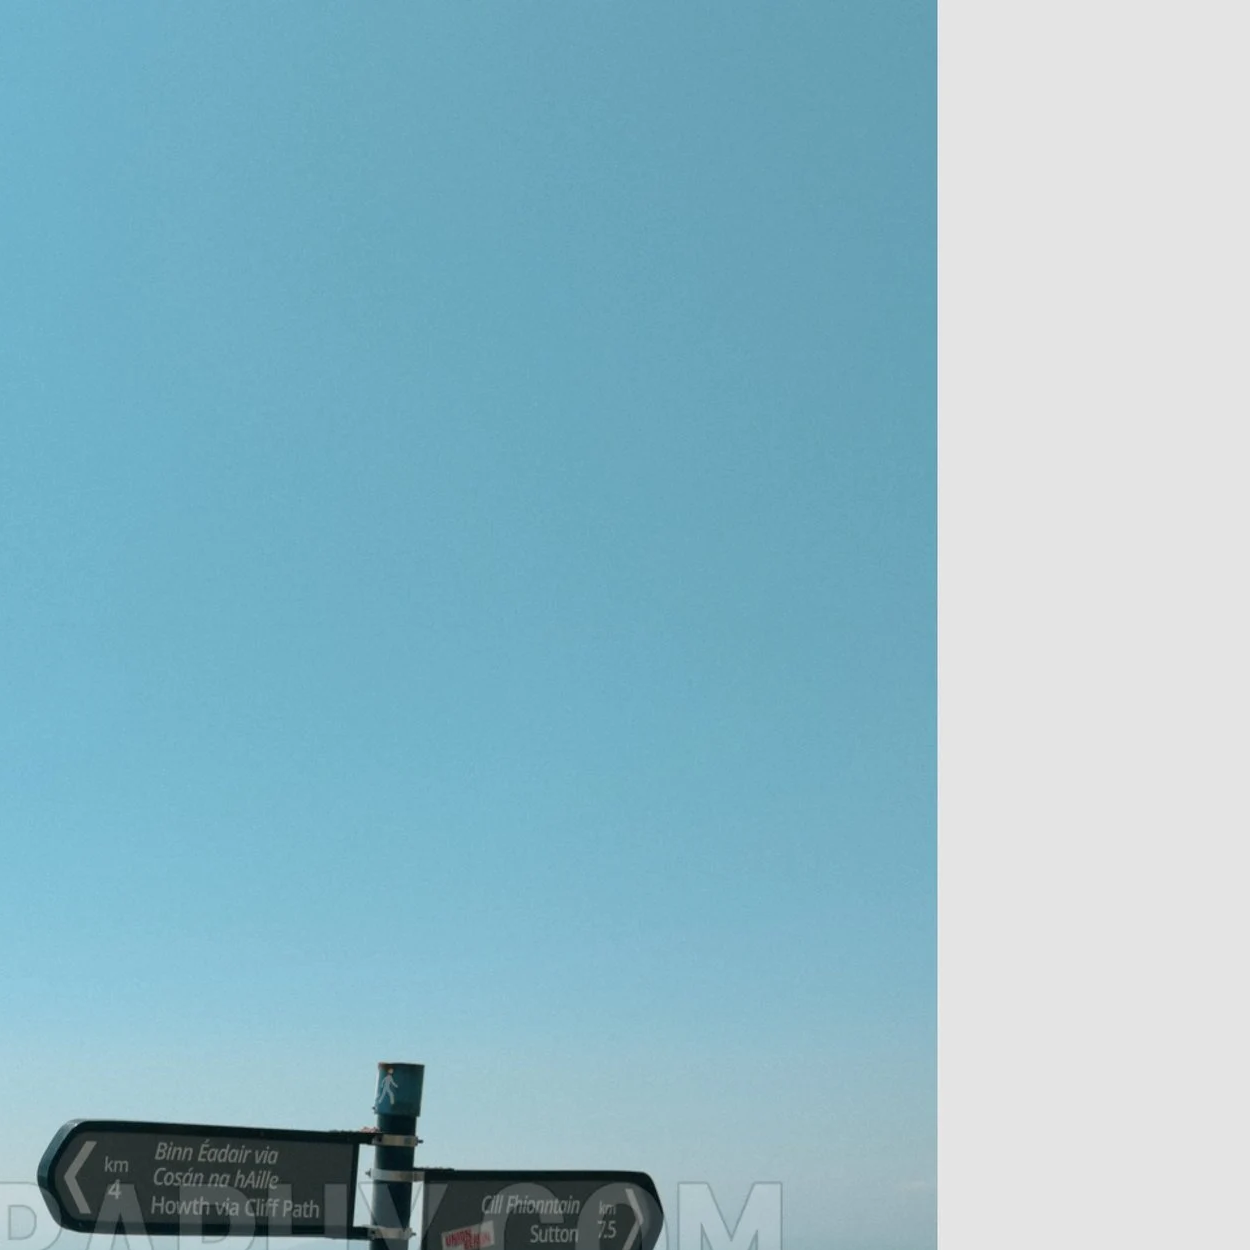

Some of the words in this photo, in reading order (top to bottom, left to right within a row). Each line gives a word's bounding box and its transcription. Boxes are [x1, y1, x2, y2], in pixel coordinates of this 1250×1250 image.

[154, 1142, 193, 1161] Binn
[198, 1138, 252, 1164] Éadair
[255, 1147, 279, 1165] via
[104, 1156, 129, 1173] km
[153, 1167, 203, 1187] Cosán
[209, 1173, 230, 1188] na
[234, 1170, 279, 1190] hAille
[107, 1179, 122, 1199] 4
[151, 1196, 212, 1216] Howth
[215, 1197, 239, 1216] via
[244, 1197, 279, 1217] Cliff
[282, 1199, 320, 1219] Path
[482, 1195, 502, 1215] Cill
[506, 1195, 580, 1215] Fhionntain
[599, 1202, 617, 1216] km
[530, 1224, 579, 1244] Sutton
[598, 1220, 617, 1239] 7.5
